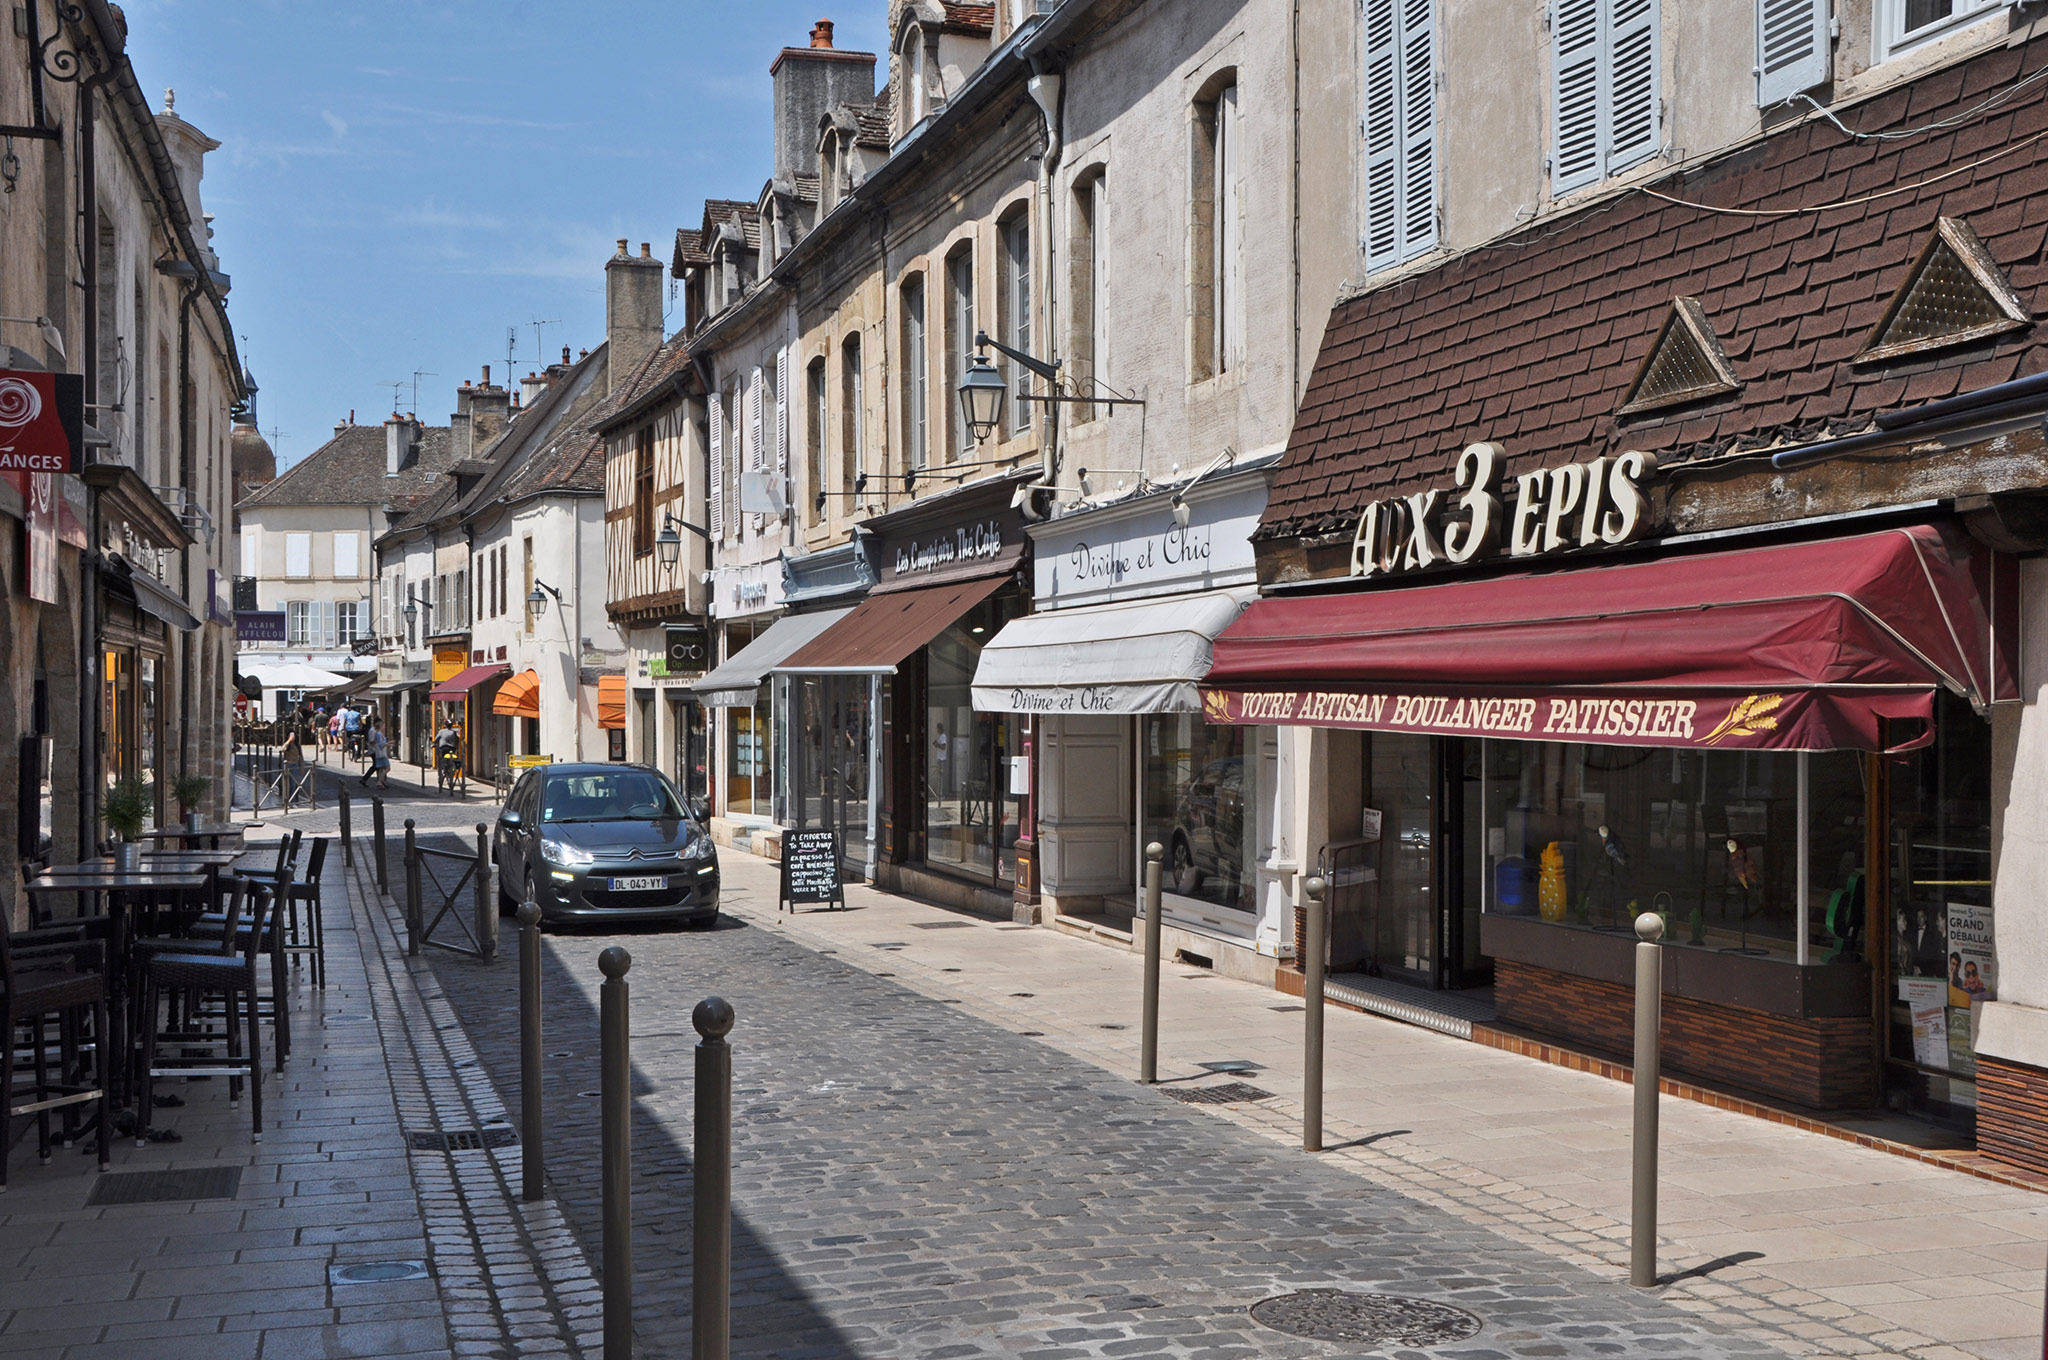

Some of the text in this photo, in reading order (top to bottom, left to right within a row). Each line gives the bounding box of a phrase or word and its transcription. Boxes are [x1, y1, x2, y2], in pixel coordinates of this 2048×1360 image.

[0, 453, 63, 470] ANGES
[1350, 441, 1644, 577] AUX 3 EPIS
[896, 520, 1001, 573] Les Comptoirs Thé Café
[1072, 521, 1211, 579] Divine et Chic
[248, 621, 275, 629] ALAIN
[239, 630, 284, 638] AFFLELOU
[1011, 687, 1113, 710] Divine et Chic
[1241, 692, 1697, 740] VOTRE ARTISAN BOULANGER PATISSIER
[615, 878, 661, 890] DL-043-VY
[1968, 907, 1973, 918] 5
[1950, 917, 1984, 931] GRAND
